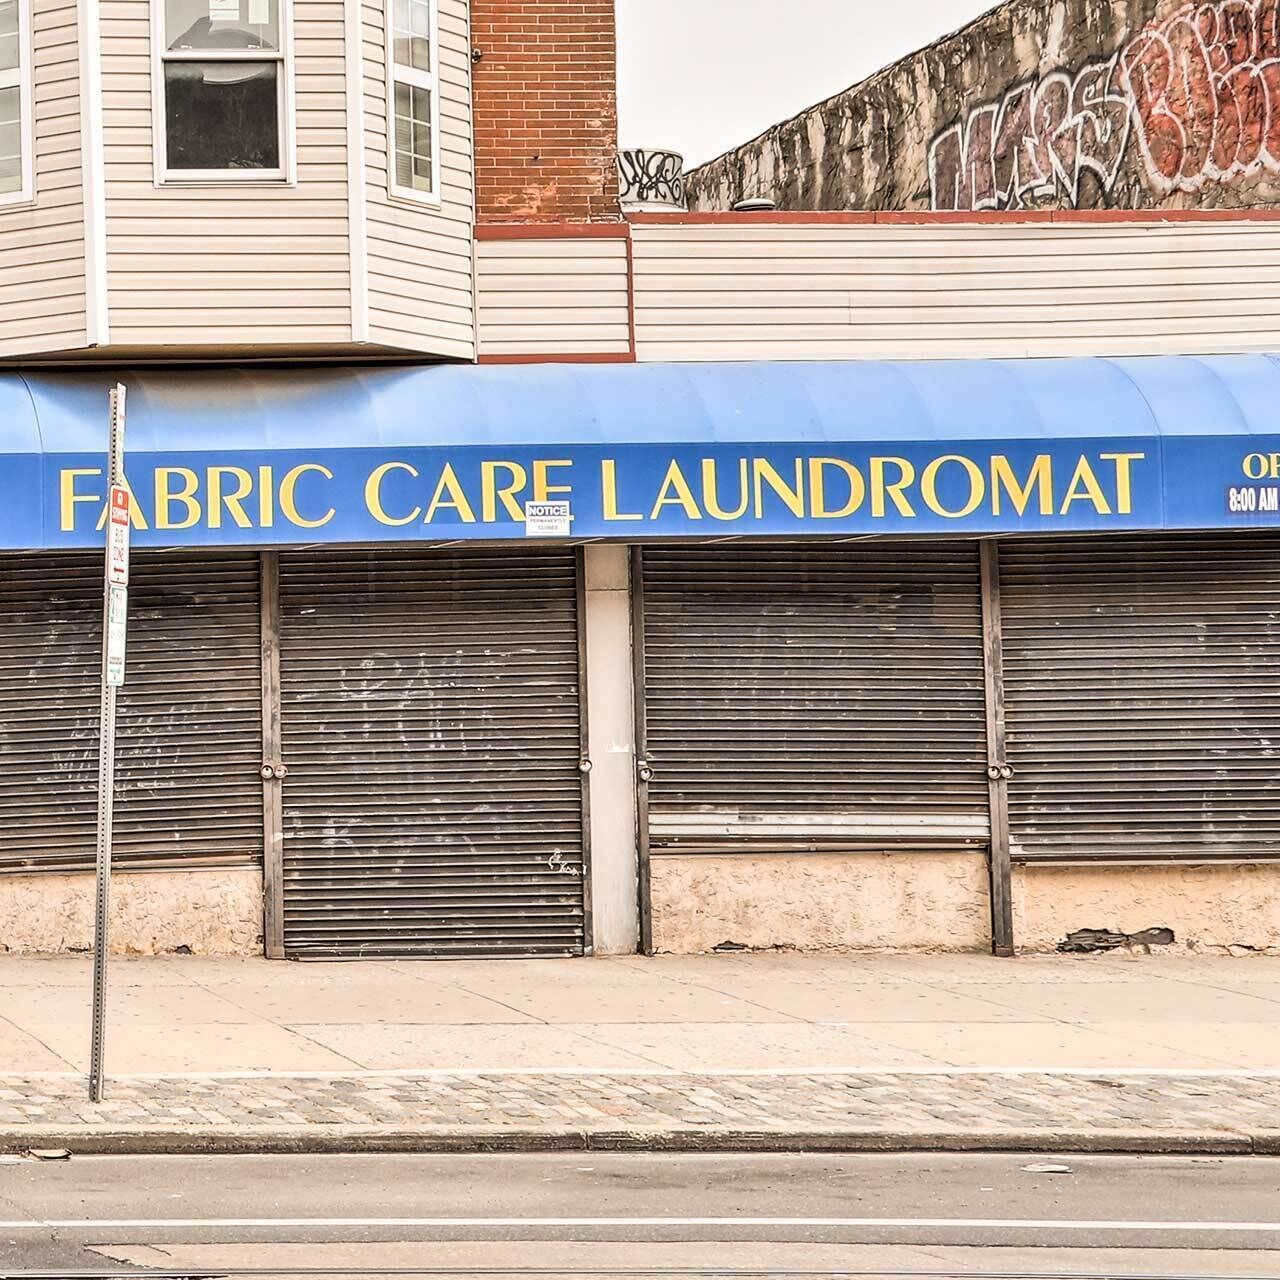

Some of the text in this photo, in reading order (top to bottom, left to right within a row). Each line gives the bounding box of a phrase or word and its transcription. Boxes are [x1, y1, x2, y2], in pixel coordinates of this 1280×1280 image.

[58, 451, 1146, 533] FABRIC CARE LAUNDROMAT
[1229, 487, 1279, 512] 8:00 AM
[528, 506, 567, 516] NOTICE
